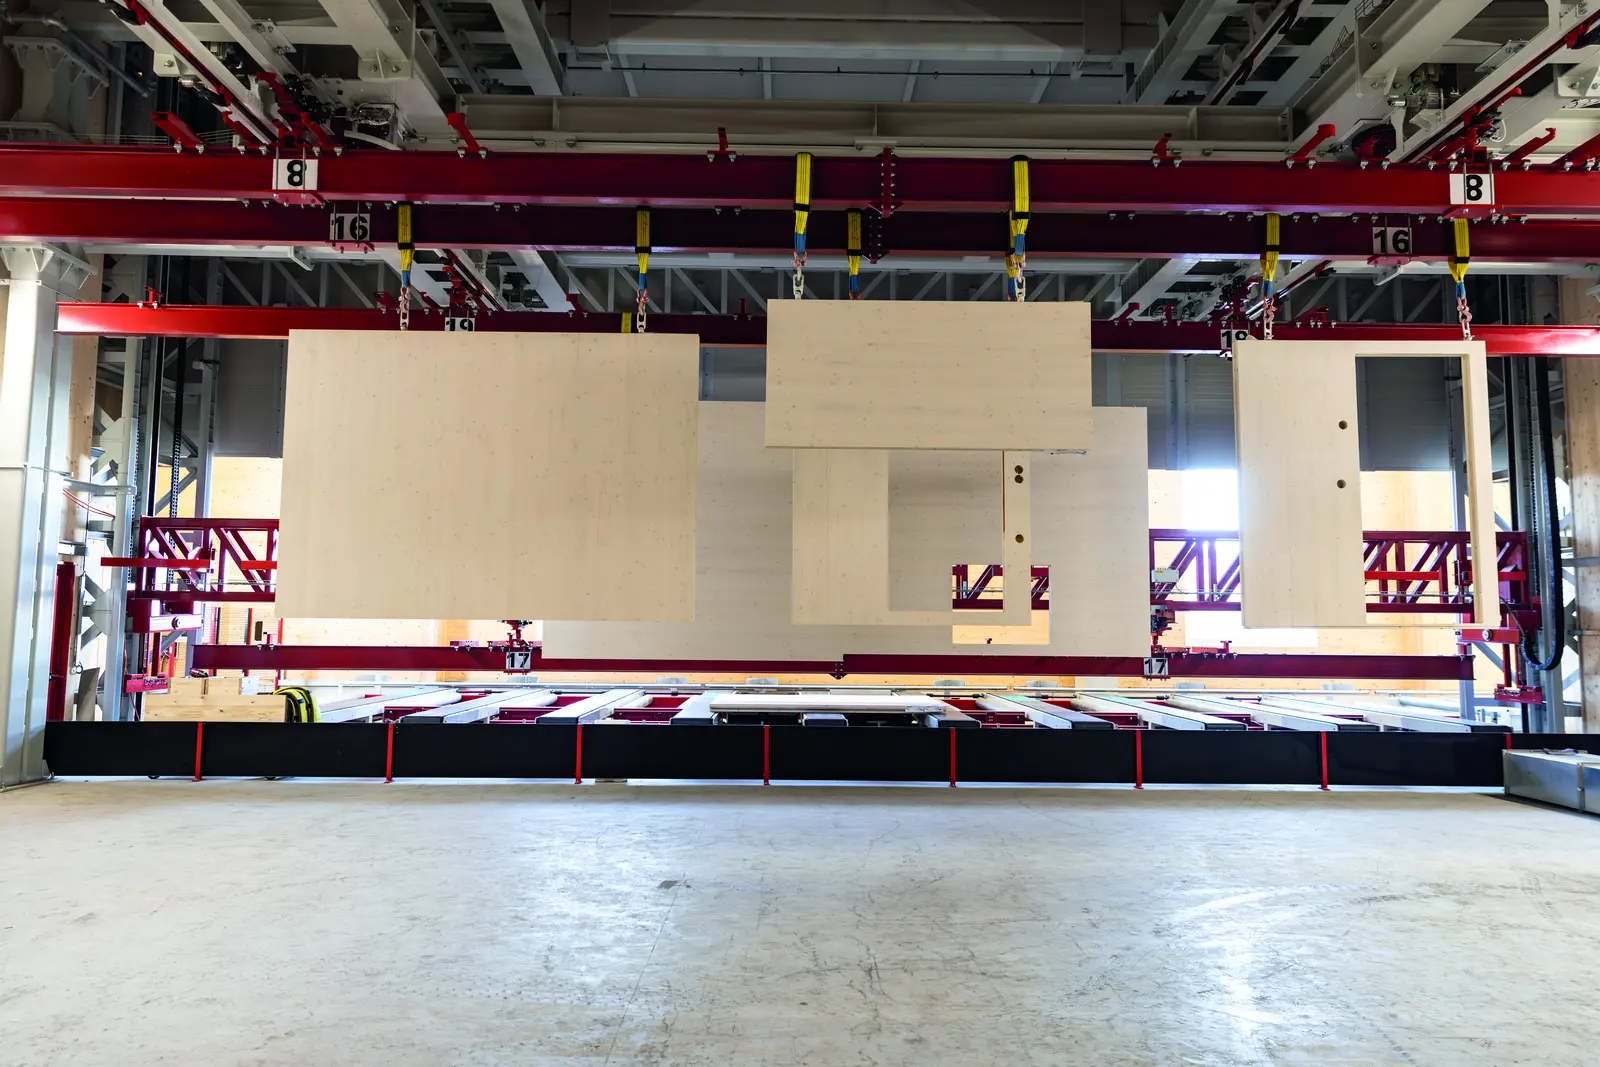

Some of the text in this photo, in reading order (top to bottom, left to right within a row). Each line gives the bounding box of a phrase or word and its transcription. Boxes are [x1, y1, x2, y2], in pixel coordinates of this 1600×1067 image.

[287, 160, 307, 186] 8
[1465, 175, 1483, 201] 8
[331, 216, 368, 240] 16
[1374, 230, 1410, 254] 16
[507, 653, 529, 667] 17
[1145, 659, 1167, 673] 17
